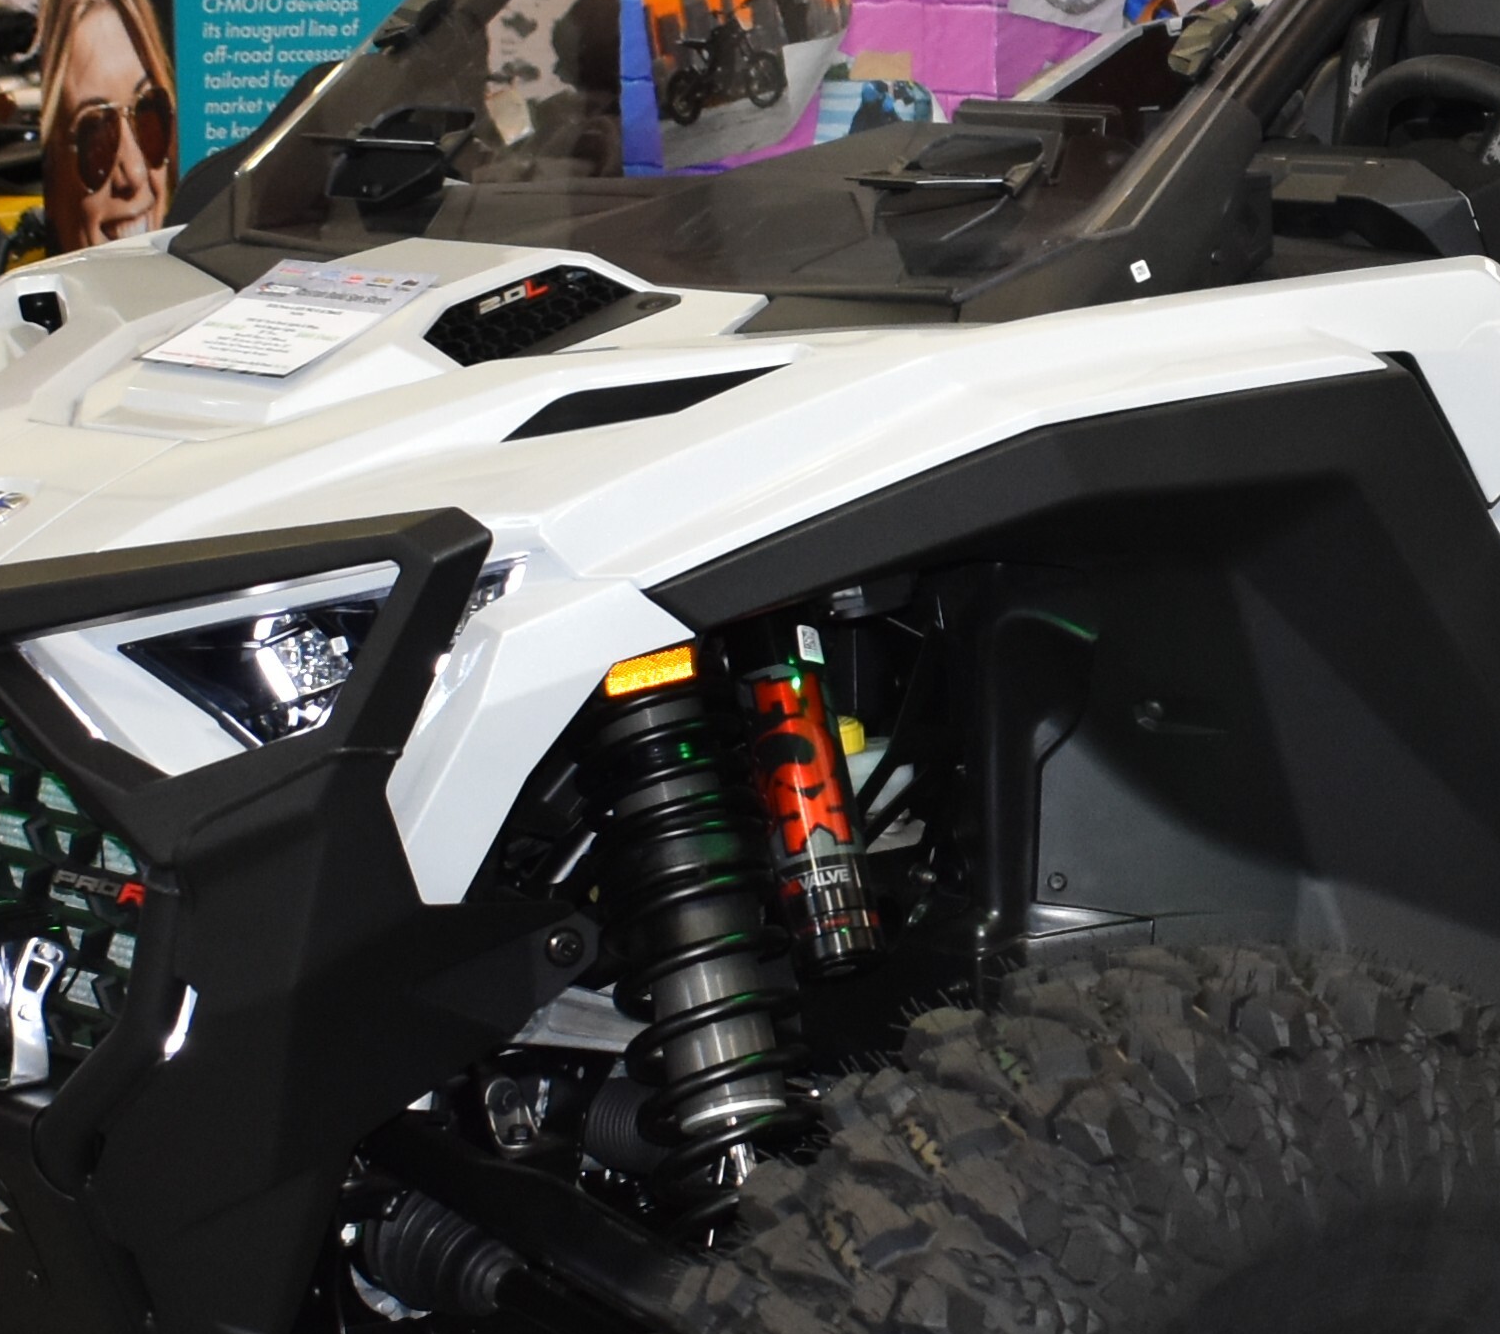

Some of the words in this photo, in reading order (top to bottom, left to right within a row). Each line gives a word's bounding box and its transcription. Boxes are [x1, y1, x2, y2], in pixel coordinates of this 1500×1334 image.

[202, 21, 221, 38] its
[225, 20, 306, 43] inaugural
[308, 20, 338, 37] line
[341, 18, 360, 37] of
[203, 44, 274, 64] off-road
[277, 47, 352, 63] accessori
[204, 71, 270, 89] tailored
[273, 71, 297, 89] for
[204, 96, 263, 115] market
[206, 122, 227, 140] be
[52, 869, 120, 899] PRO
[799, 866, 851, 891] VALVE
